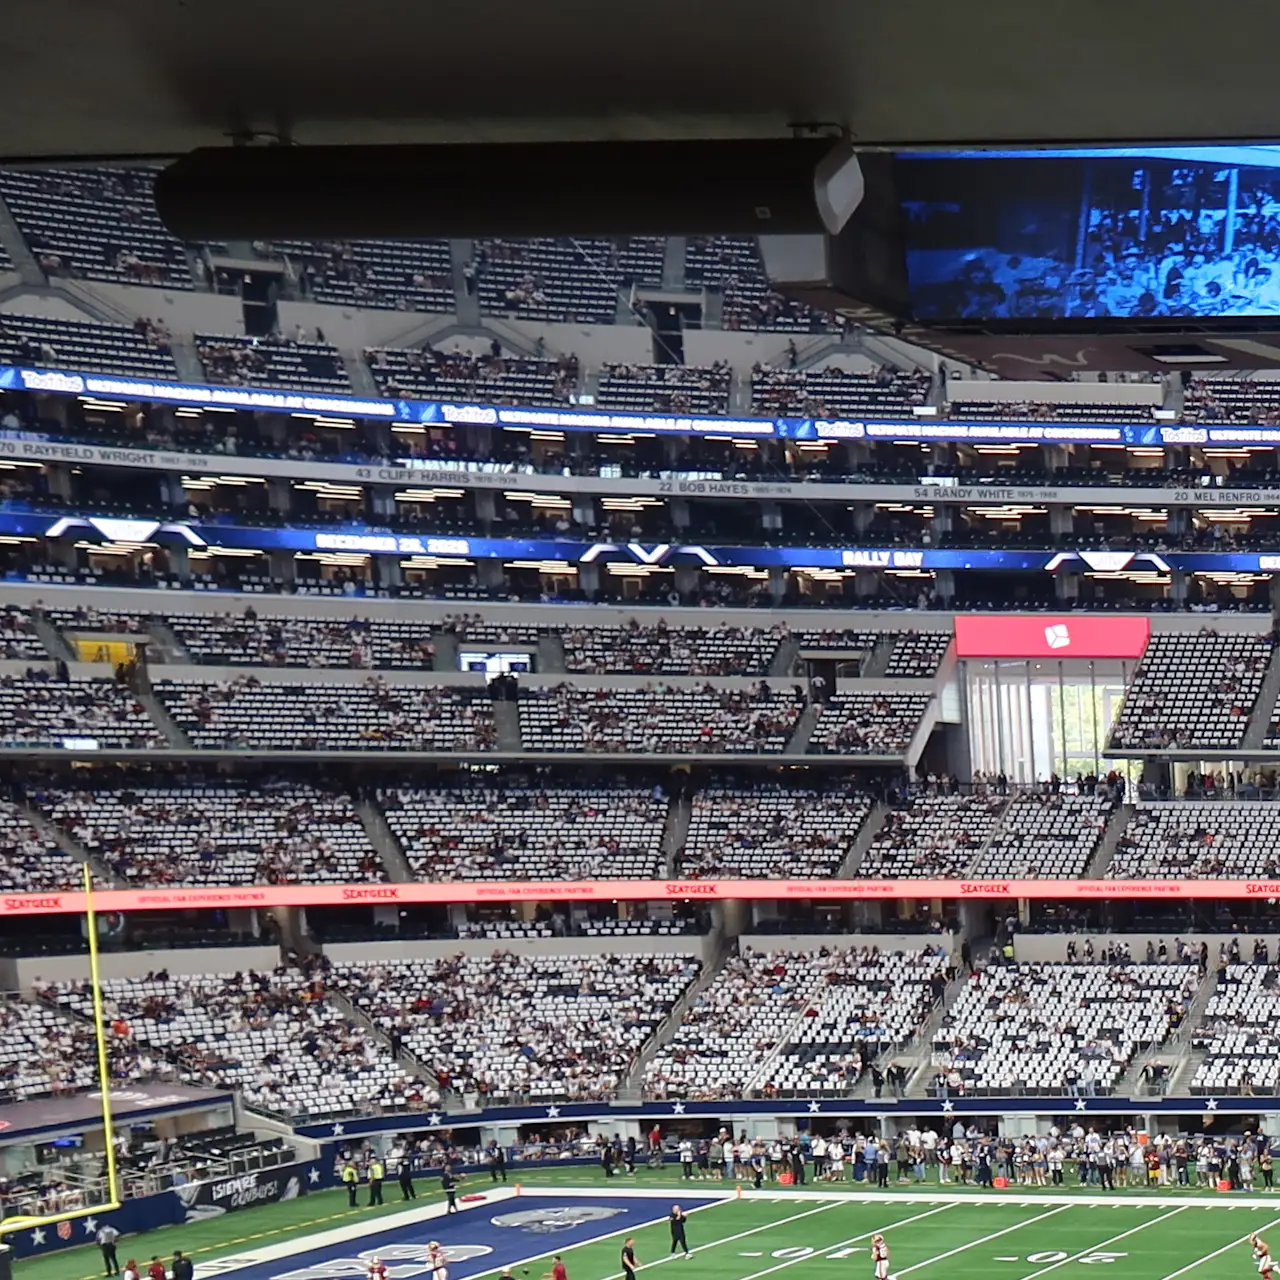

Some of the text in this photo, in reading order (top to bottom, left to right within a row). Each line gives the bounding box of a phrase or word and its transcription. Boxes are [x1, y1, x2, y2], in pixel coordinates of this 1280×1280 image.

[22, 372, 83, 391] Tostitos
[443, 406, 496, 423] Tostitos
[816, 422, 863, 437] Tostitos
[1162, 428, 1207, 442] Tostitos
[23, 446, 94, 458] RAYFIELD
[100, 449, 155, 462] WRIGHT
[378, 468, 414, 478] CLIFF
[421, 473, 470, 482] HARRIS
[679, 483, 705, 492] BOB
[709, 484, 749, 493] HAYES
[934, 490, 972, 498] RANDY
[976, 490, 1014, 499] WHITE
[1193, 493, 1213, 501] MEL
[1216, 493, 1260, 502] RENFRO
[316, 535, 396, 550] DECEMBER
[843, 551, 923, 566] RALLY DAY
[343, 889, 400, 900] SEATGEEK
[666, 885, 717, 895] SEATGEEK
[960, 885, 1010, 895] SEATGEEK
[5, 899, 62, 909] SEATGEEK
